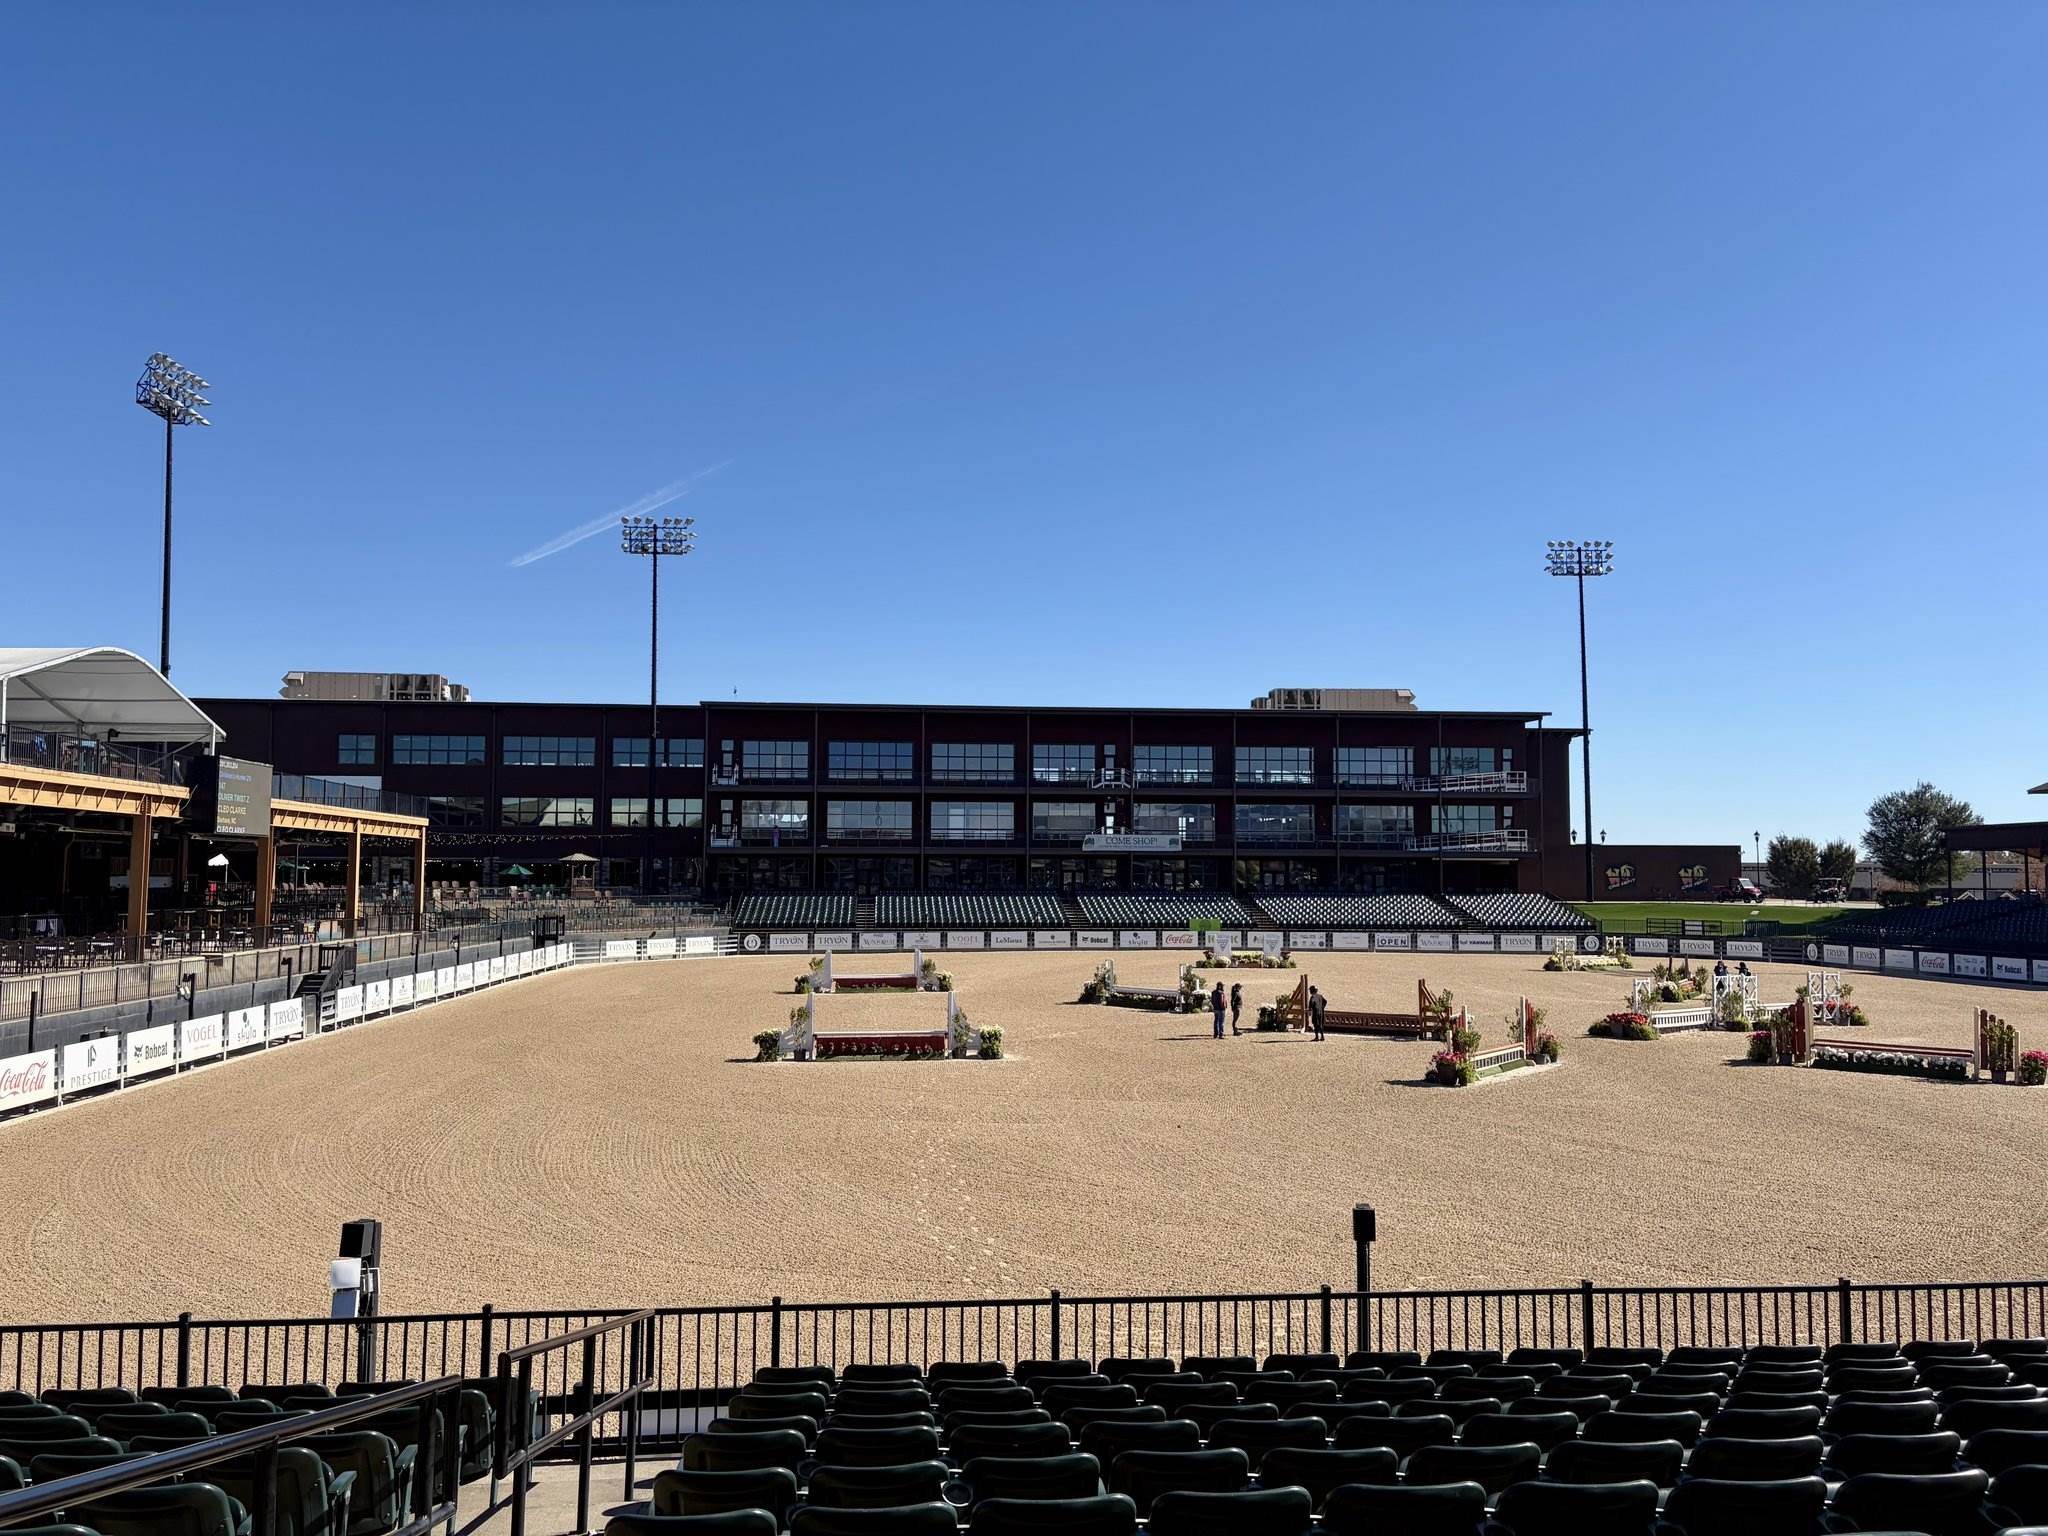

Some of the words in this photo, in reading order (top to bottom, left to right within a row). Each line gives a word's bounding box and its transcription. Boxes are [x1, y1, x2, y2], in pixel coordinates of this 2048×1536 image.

[1105, 836, 1130, 845] COME
[774, 936, 804, 945] TRYON
[818, 936, 848, 945] TRYON
[1380, 938, 1407, 946] OPEN
[1503, 938, 1533, 946] TRYON
[1637, 940, 1665, 949] TRYON
[609, 943, 635, 953] TRYON
[1682, 942, 1711, 951] TRYON
[1730, 944, 1760, 952] TRYON
[1826, 948, 1846, 957] TRYON
[1856, 951, 1877, 960] TRYON
[2004, 965, 2022, 974] Bobcat
[273, 1006, 299, 1026] TRYON
[187, 1024, 217, 1043] VOGEL
[145, 1042, 168, 1060] Bobcat
[71, 1068, 112, 1089] PRESTIGE
